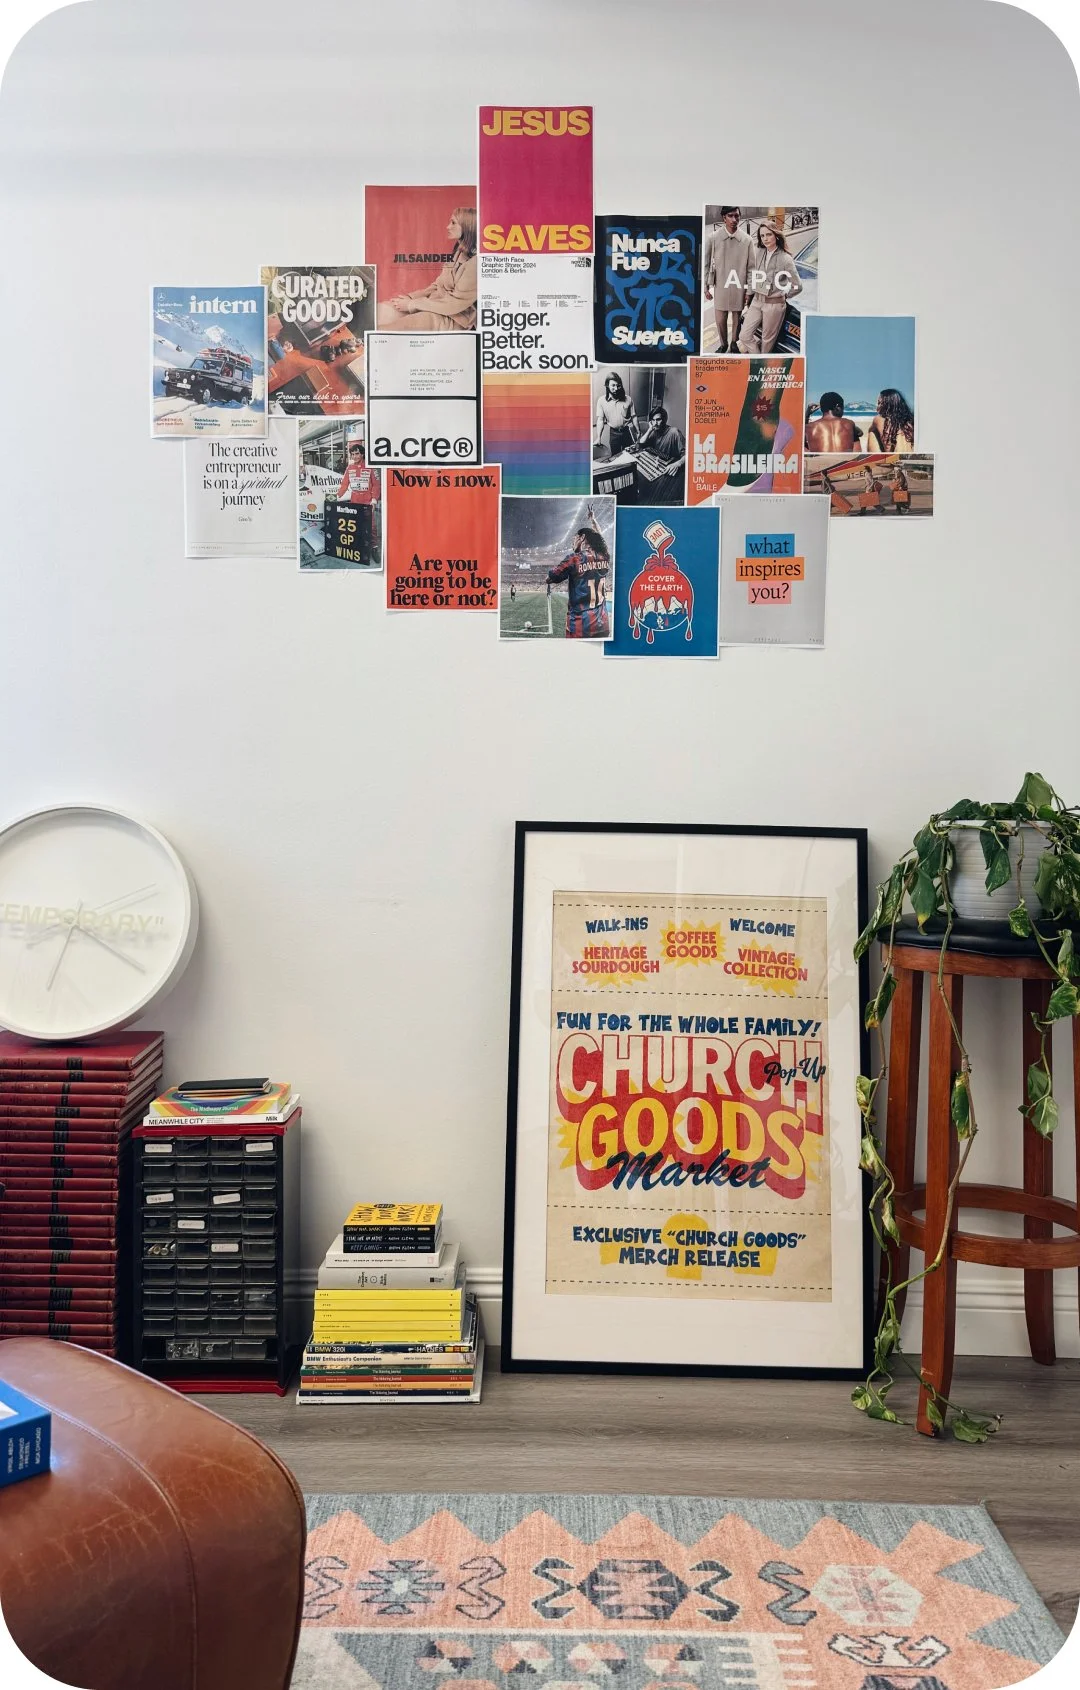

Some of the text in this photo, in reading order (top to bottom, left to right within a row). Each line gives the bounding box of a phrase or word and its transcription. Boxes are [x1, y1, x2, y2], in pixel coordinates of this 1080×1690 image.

[482, 109, 591, 136] JESUS
[482, 224, 592, 251] SAVES
[611, 233, 681, 253] Nunca
[611, 252, 650, 271] Fue
[723, 269, 799, 290] A.P.C.
[189, 295, 259, 315] intern
[283, 300, 354, 323] GOODS
[481, 308, 550, 331] Bigger.
[481, 331, 545, 349] Better.
[611, 326, 689, 346] Suerte.
[482, 350, 594, 370] Back soon.
[760, 381, 804, 389] AMERICA
[275, 391, 296, 402] From
[312, 392, 330, 400] desk
[341, 394, 361, 403] yours
[208, 442, 278, 457] The creative
[693, 433, 716, 453] LA
[205, 462, 282, 478] entrepreneur
[693, 454, 799, 474] BRASILEIRA
[203, 475, 288, 495] is on a spiritual
[390, 469, 432, 488] Now
[436, 471, 450, 488] is
[454, 473, 497, 488] now.
[220, 491, 266, 511] journey
[336, 505, 358, 515] Marlboro
[300, 511, 324, 520] Shell
[337, 518, 357, 532] 25
[339, 534, 354, 546] GP
[650, 527, 666, 543] LOVE
[335, 546, 361, 562] WINS
[750, 537, 790, 554] what
[409, 553, 478, 575] Are you
[739, 560, 801, 580] inspires
[395, 571, 492, 592] going to be
[640, 584, 683, 592] THE EARTH
[648, 575, 675, 583] COVER
[390, 589, 497, 606] here or not?
[751, 583, 789, 601] you?
[0, 902, 165, 933] EMPORARY"
[585, 917, 649, 934] WALK-INS
[729, 918, 796, 938] WELCOME
[666, 931, 717, 945] COFFEE
[584, 946, 648, 960] HERITAGE
[666, 945, 718, 959] GOODS
[738, 948, 796, 966] VINTAGE
[572, 960, 660, 974] SOURDOUGH
[723, 961, 808, 981] COLLECTION
[557, 1012, 822, 1038] FUN FOR THE WHOLE FAMILY!
[556, 1032, 824, 1122] CHURCH
[763, 1056, 827, 1086] Pop-Up
[148, 1117, 189, 1126] MEANWHILE
[189, 1117, 205, 1125] CITY
[576, 1096, 806, 1192] GOODS
[606, 1148, 772, 1191] Market
[572, 1225, 662, 1244] EXCLUSIVE
[618, 1246, 761, 1268] MERCH RELEASE
[353, 1355, 382, 1363] Companion
